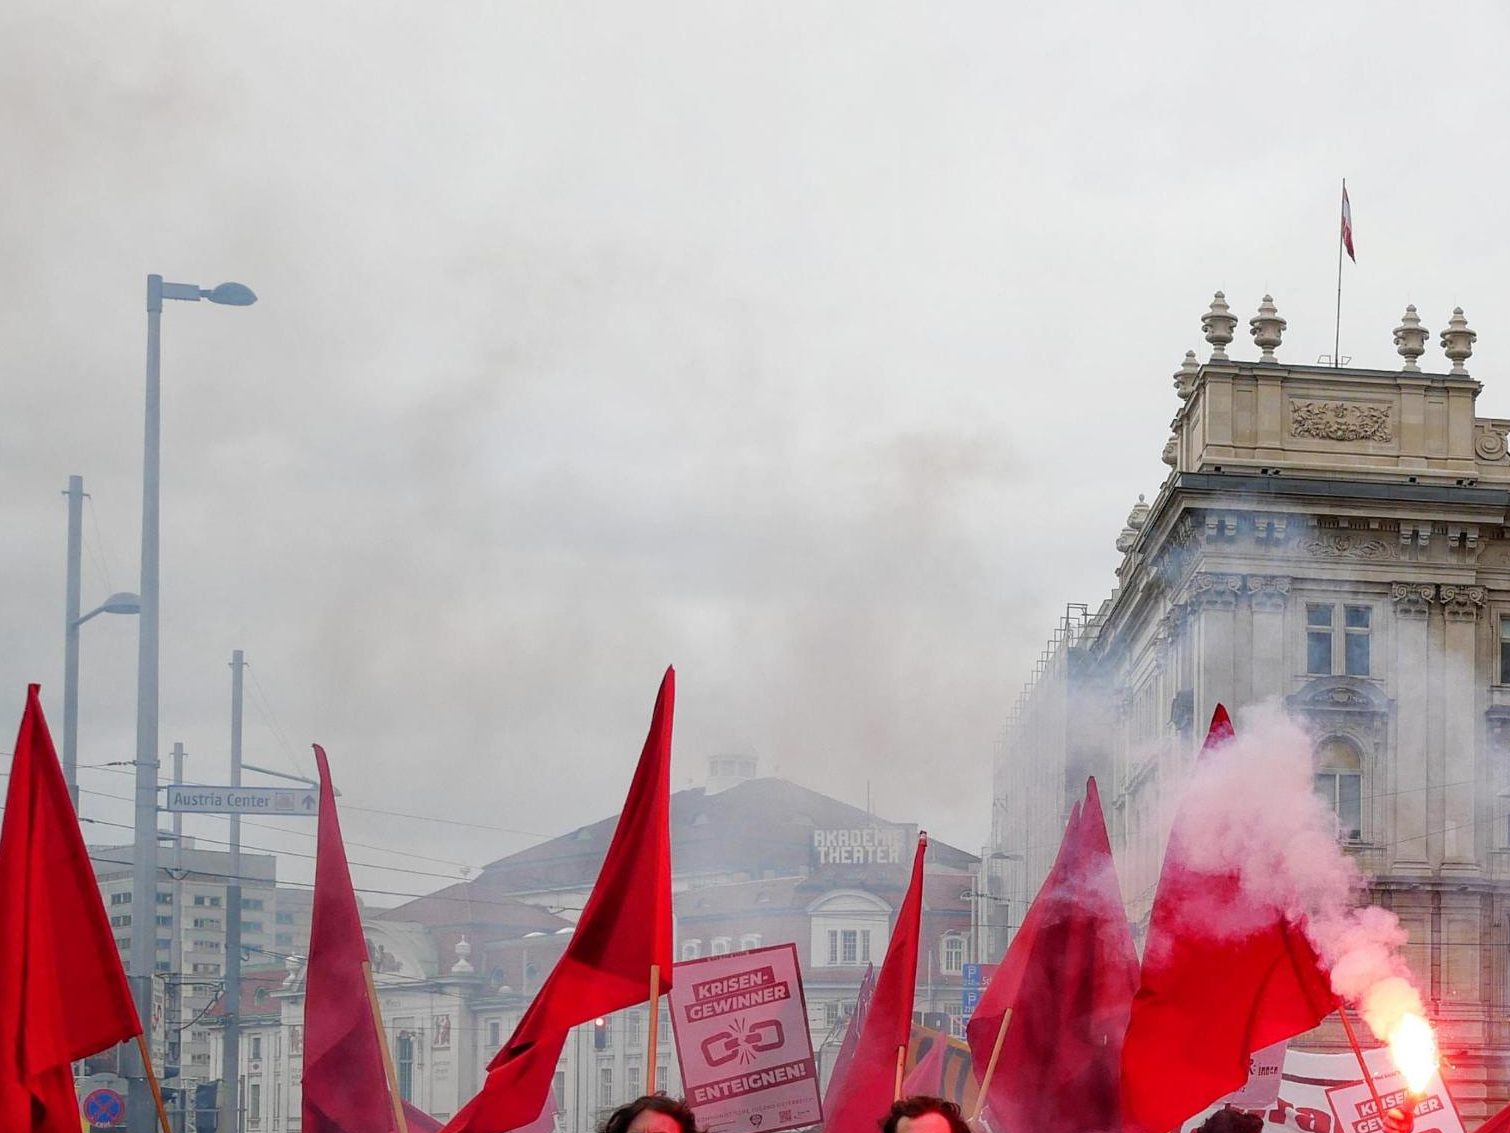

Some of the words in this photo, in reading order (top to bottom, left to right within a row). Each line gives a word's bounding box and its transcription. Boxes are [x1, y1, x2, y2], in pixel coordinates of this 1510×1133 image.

[173, 792, 222, 806] Austria
[227, 793, 270, 808] Center
[817, 846, 899, 864] THEATER
[698, 970, 769, 1000] KRISEN-
[689, 985, 787, 1019] GEWINNER
[693, 1063, 807, 1103] ENTEIGNEN!
